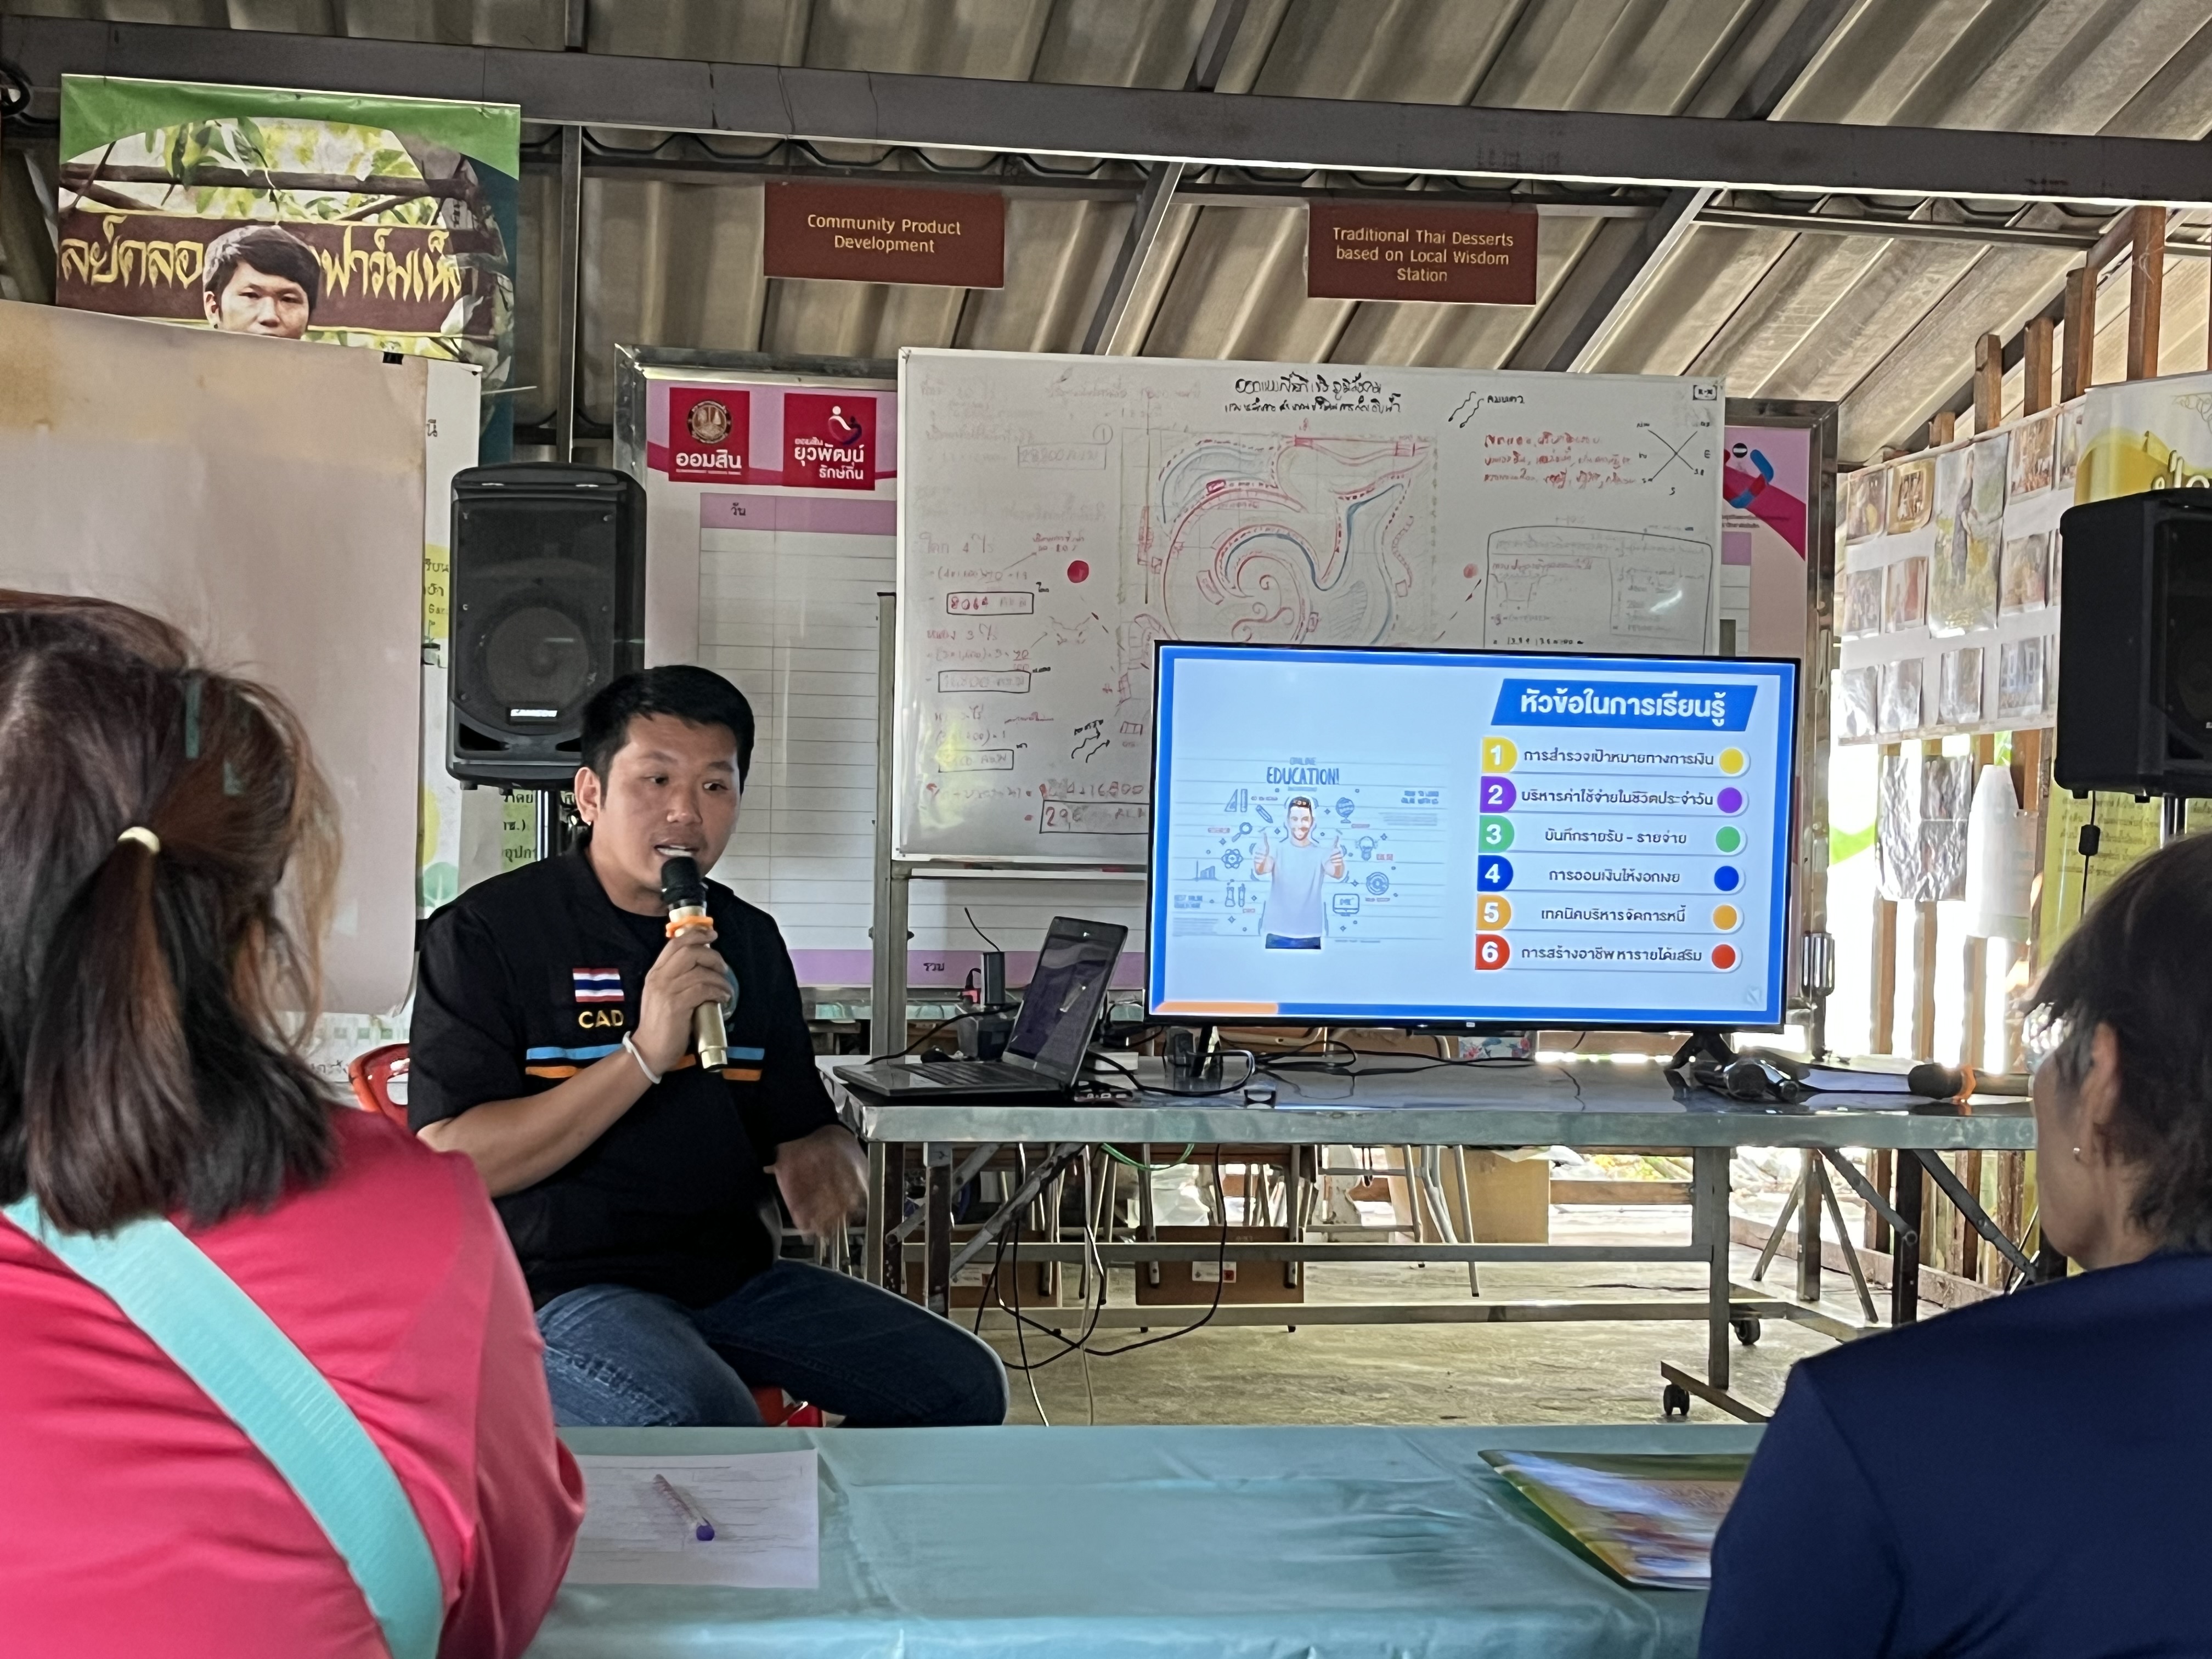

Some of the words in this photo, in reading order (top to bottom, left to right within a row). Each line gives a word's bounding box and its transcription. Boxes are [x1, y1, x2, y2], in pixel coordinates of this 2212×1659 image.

[808, 214, 895, 234] Community
[902, 218, 961, 235] Product
[834, 235, 935, 254] Development
[1333, 227, 1409, 242] Traditional
[1416, 229, 1446, 244] Thai
[1452, 232, 1514, 247] Desserts
[1336, 245, 1379, 261] based
[1385, 251, 1403, 262] on
[1410, 249, 1447, 263] Local
[1453, 251, 1509, 265] Wisdom
[1397, 267, 1447, 282] Station
[676, 449, 742, 469] ออมสิน
[794, 443, 865, 467] ยุวพัฒน์
[731, 502, 746, 516] วัน
[1520, 687, 1726, 727] หัวข้อในการเรียนรู้
[1490, 745, 1501, 765] 1
[1523, 748, 1714, 766] การสำรวจเป้าหมายทางการเงิน
[1266, 766, 1340, 785] EDUCATION!
[1488, 785, 1503, 805] 2
[1521, 788, 1714, 806] บริหารค่าใช้จ่ายในชีวิตประจำวัน
[1486, 824, 1502, 844] 3
[1545, 829, 1623, 843] บันทึกรายรับ
[1637, 830, 1687, 844] รายจ่าย
[505, 845, 537, 863] อุปก
[1485, 864, 1500, 884] 4
[1549, 868, 1680, 883] การออมเงินให้งอกเงย
[1483, 902, 1499, 923] 5
[1541, 904, 1686, 923] เทคนิคบริหารจัดการหนี้
[1481, 941, 1499, 962] 6
[1521, 945, 1615, 961] การสร้างอาชีพ
[923, 962, 945, 972] รวม
[578, 1009, 624, 1029] CAD
